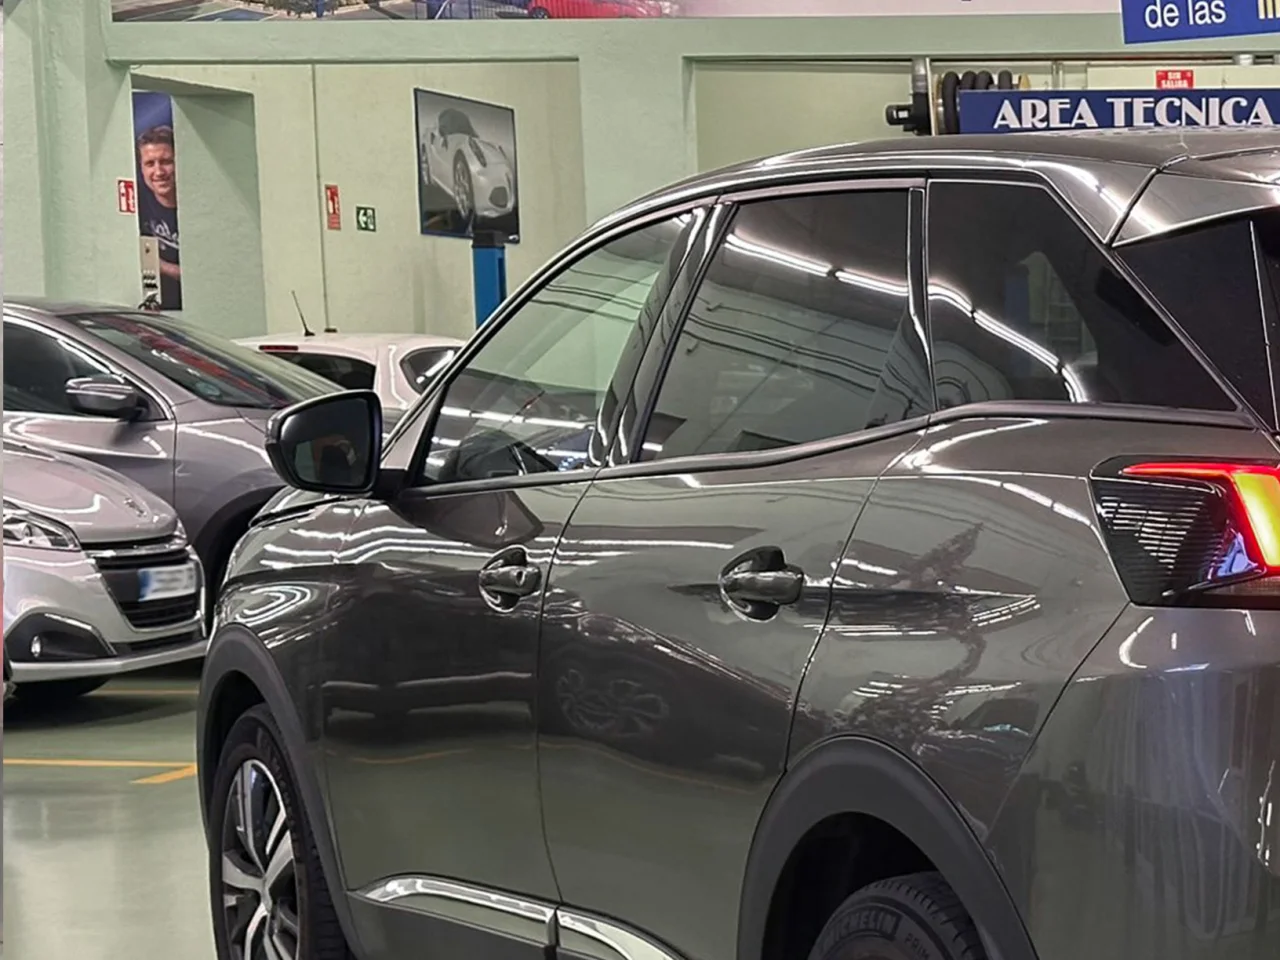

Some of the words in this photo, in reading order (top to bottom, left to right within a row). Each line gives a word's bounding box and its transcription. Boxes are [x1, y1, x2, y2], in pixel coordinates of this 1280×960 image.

[1145, 0, 1179, 28] de
[1188, 0, 1227, 25] las
[993, 97, 1098, 129] AREA
[1106, 97, 1274, 127] TECNICA
